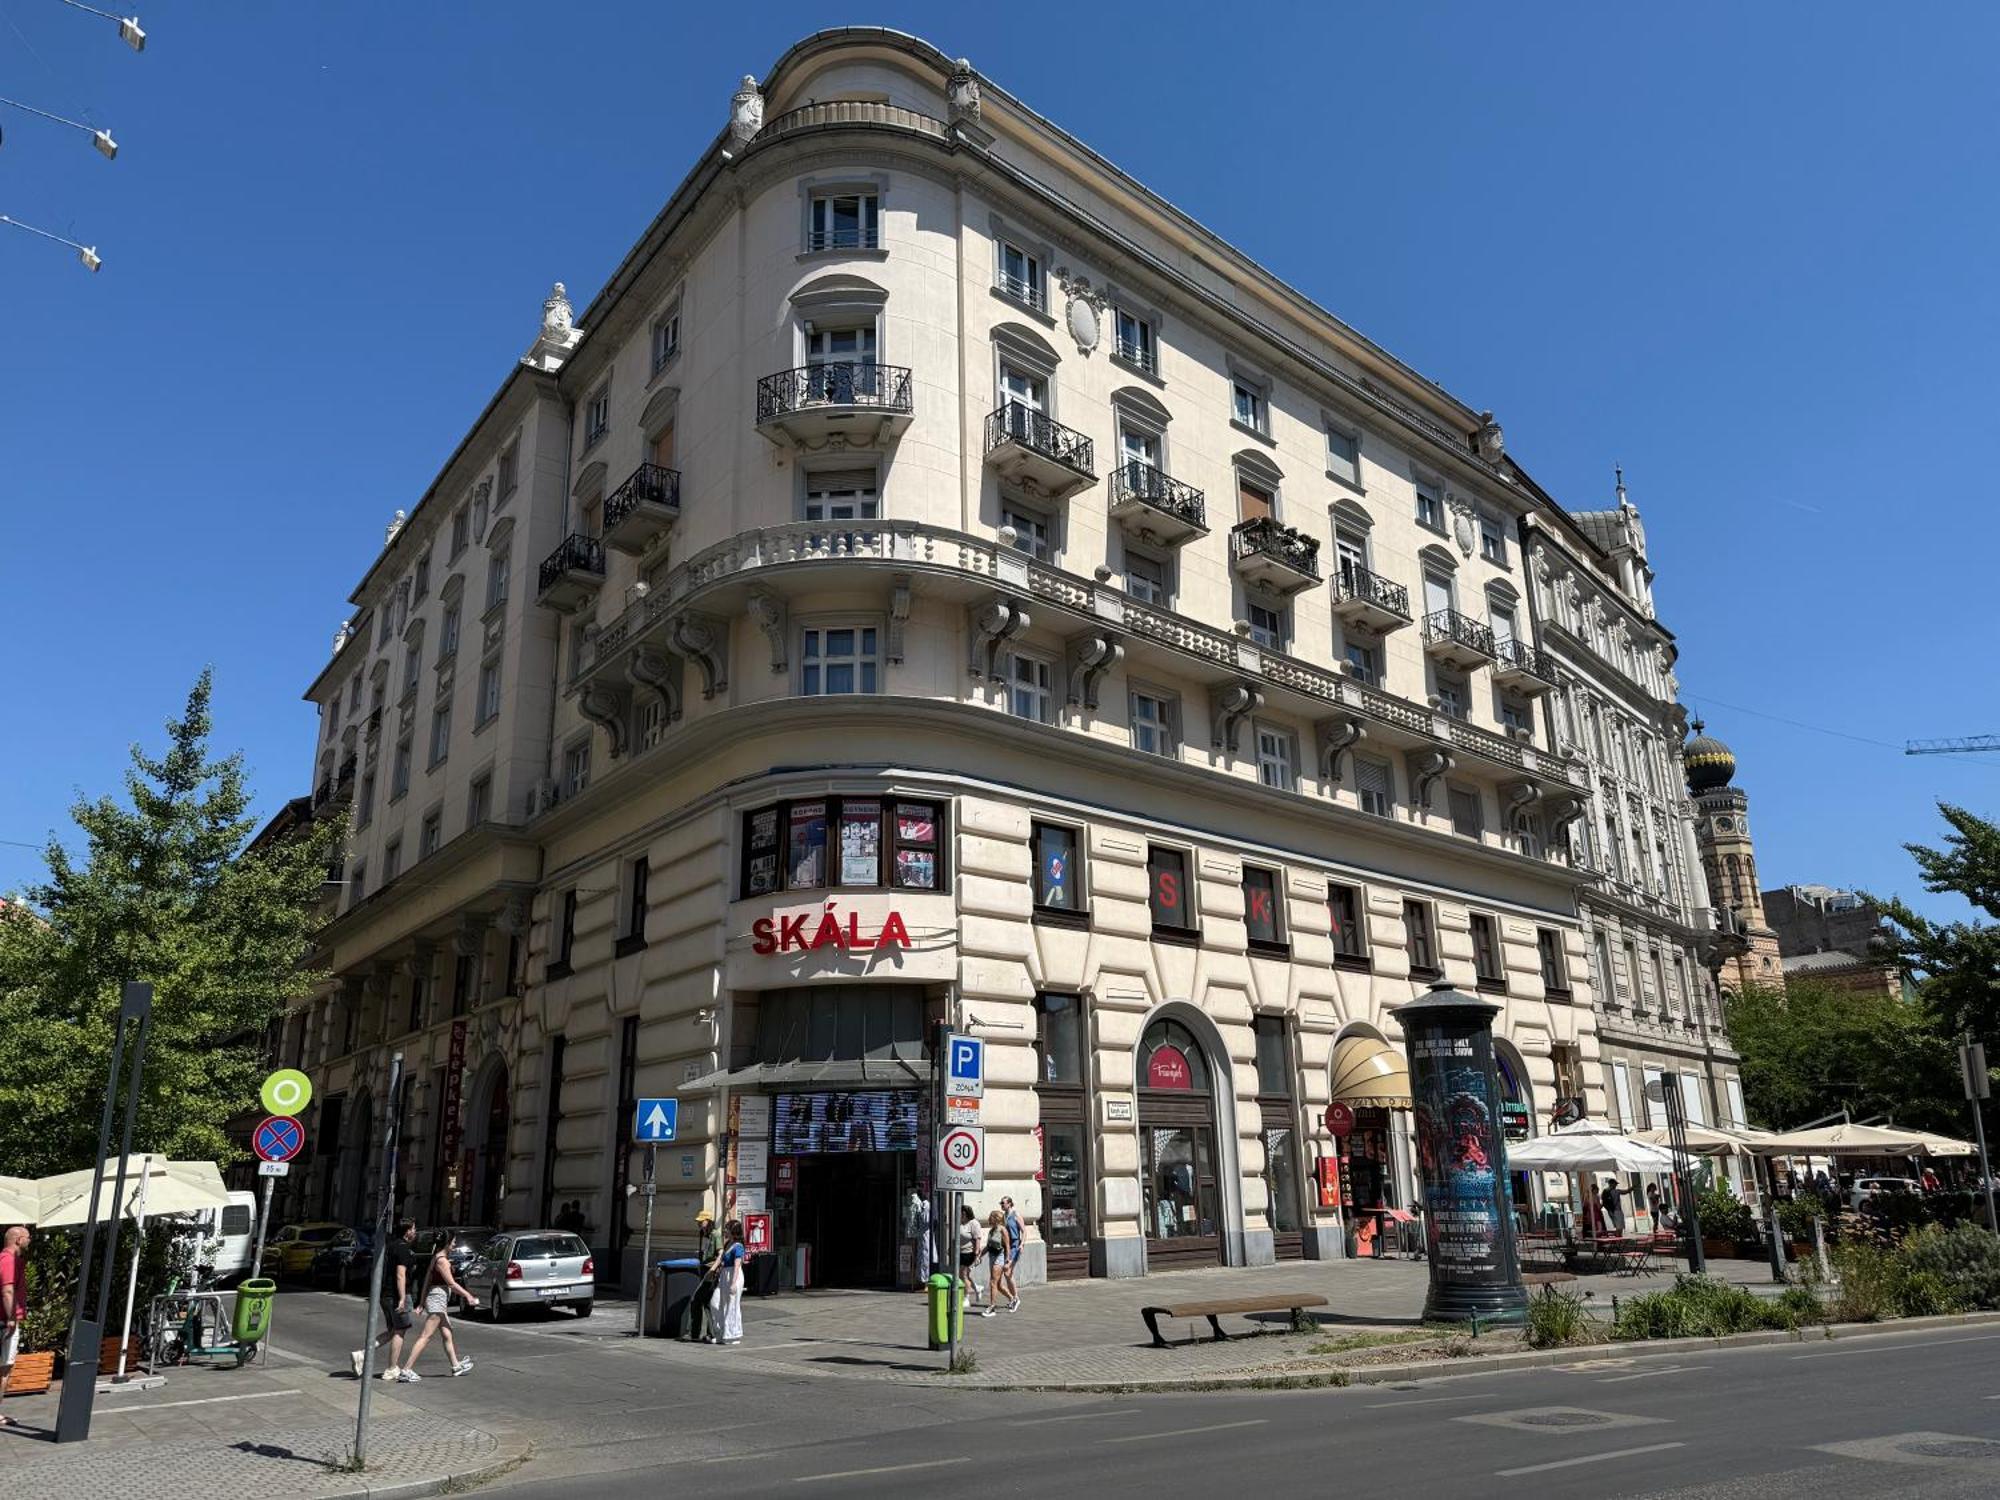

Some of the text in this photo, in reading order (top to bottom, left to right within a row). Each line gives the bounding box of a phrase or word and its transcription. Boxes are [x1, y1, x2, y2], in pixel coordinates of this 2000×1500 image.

[1158, 873, 1271, 924] S K
[752, 902, 912, 955] SKÁLA
[1453, 1038, 1470, 1047] ONLY
[1454, 1047, 1473, 1057] SHOW
[958, 1046, 973, 1074] P
[954, 1143, 971, 1159] 30
